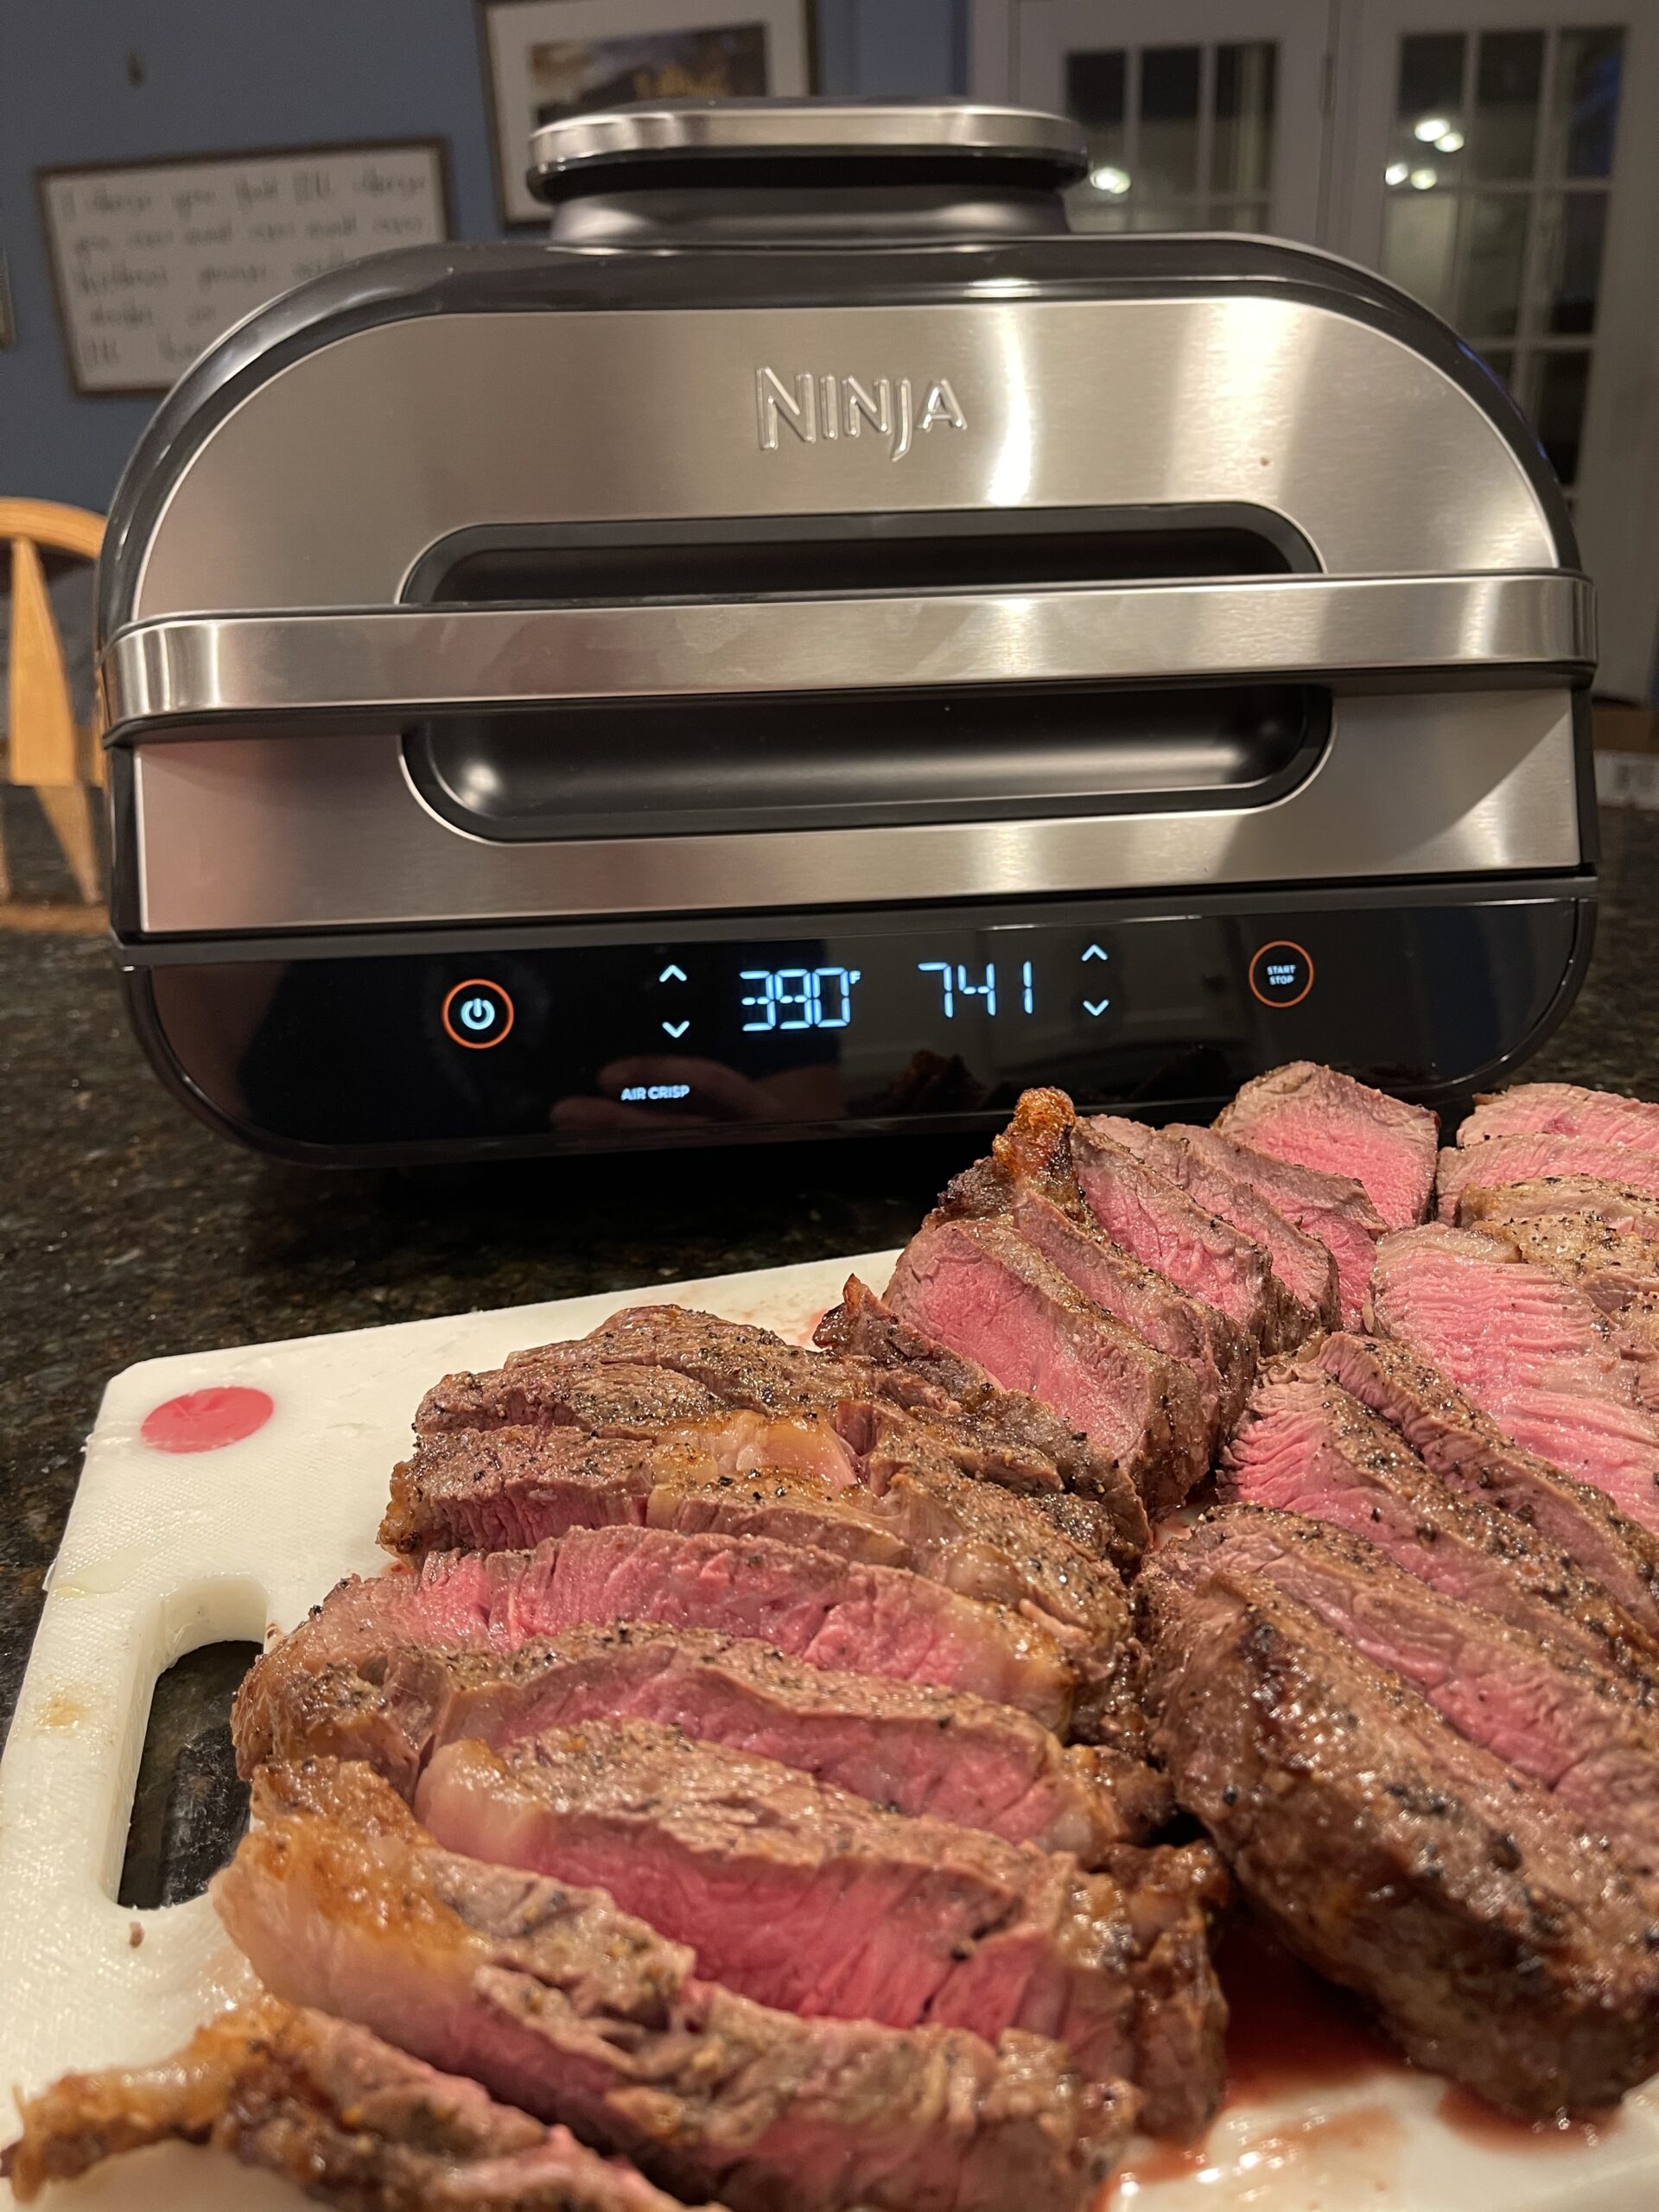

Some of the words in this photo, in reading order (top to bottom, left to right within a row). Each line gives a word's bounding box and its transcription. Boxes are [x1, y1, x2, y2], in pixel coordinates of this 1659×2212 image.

[756, 366, 968, 462] NINJA
[1267, 964, 1296, 976] START
[1269, 975, 1294, 985] STOP
[620, 1087, 646, 1101] AIR
[647, 1084, 690, 1100] CRISP
